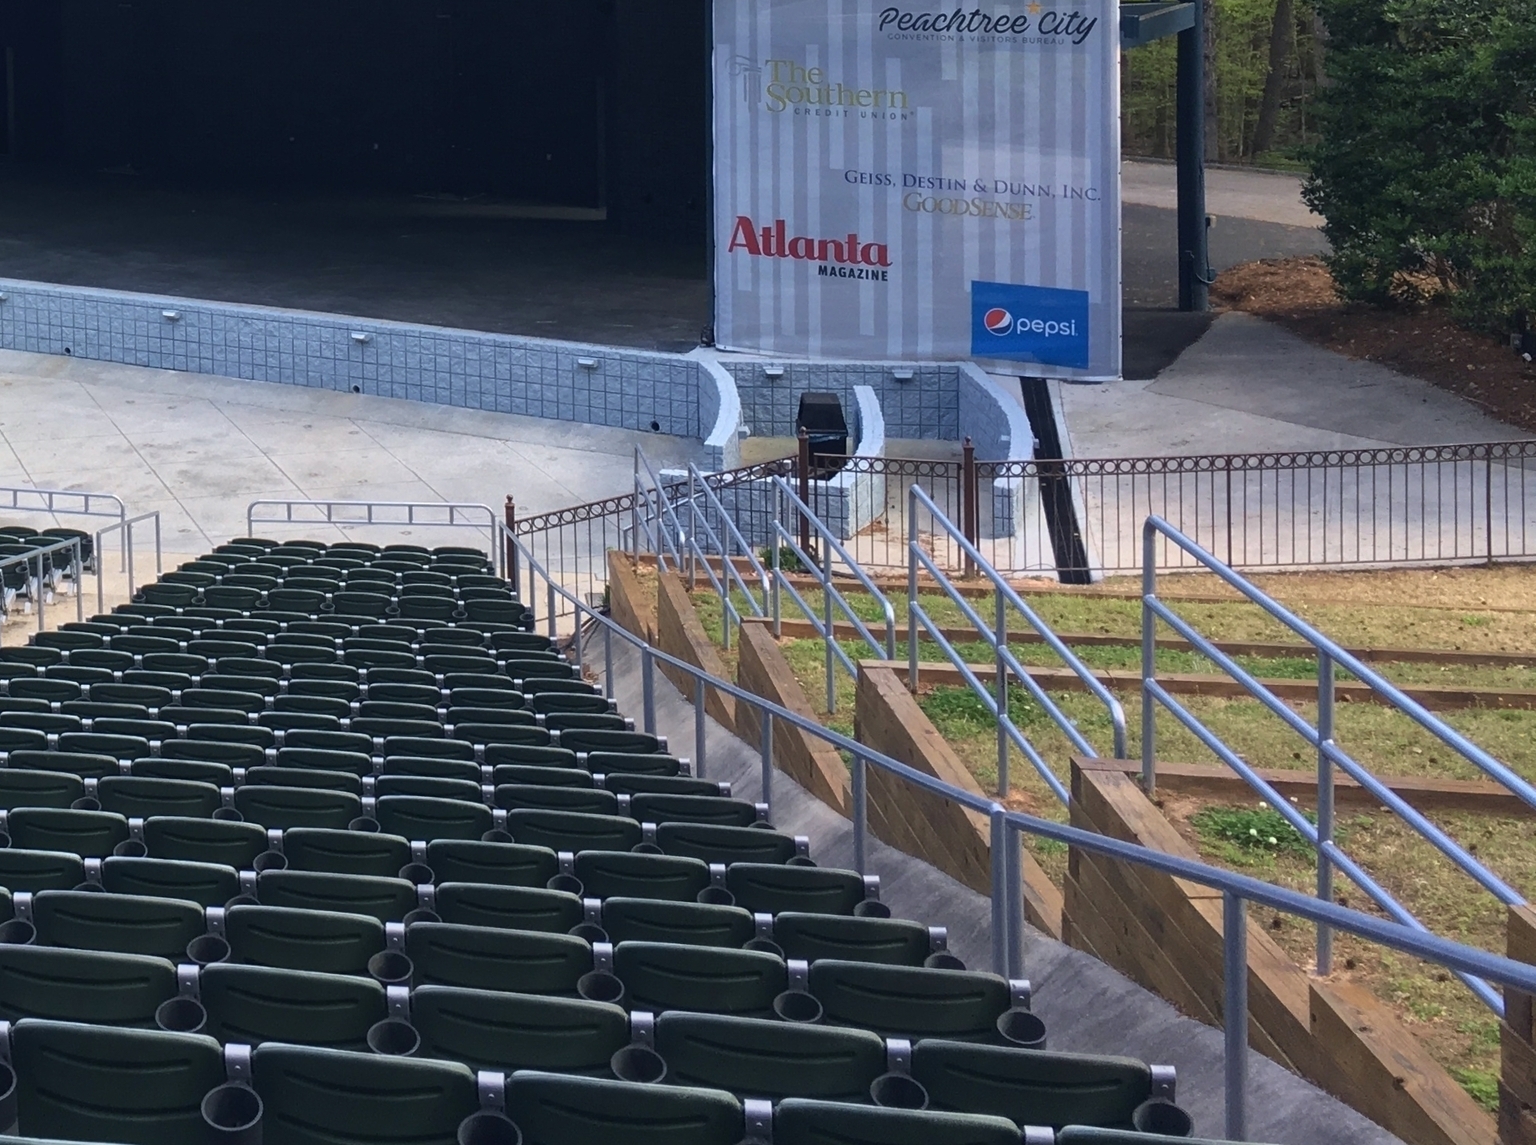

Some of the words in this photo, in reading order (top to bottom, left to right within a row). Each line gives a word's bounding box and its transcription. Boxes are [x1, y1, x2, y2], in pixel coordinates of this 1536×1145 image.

[879, 7, 1031, 34] Peachtree
[1038, 11, 1098, 45] City
[888, 33, 954, 42] CONVENTION
[969, 35, 1017, 44] VISITORS
[1022, 37, 1064, 45] BUREAU
[765, 59, 823, 85] The
[765, 73, 909, 113] Southern
[794, 107, 848, 118] CREDIT
[973, 178, 987, 193] &
[728, 215, 893, 267] Atlanta
[818, 264, 888, 282] MAGAZINE
[1017, 317, 1076, 337] pepsi
